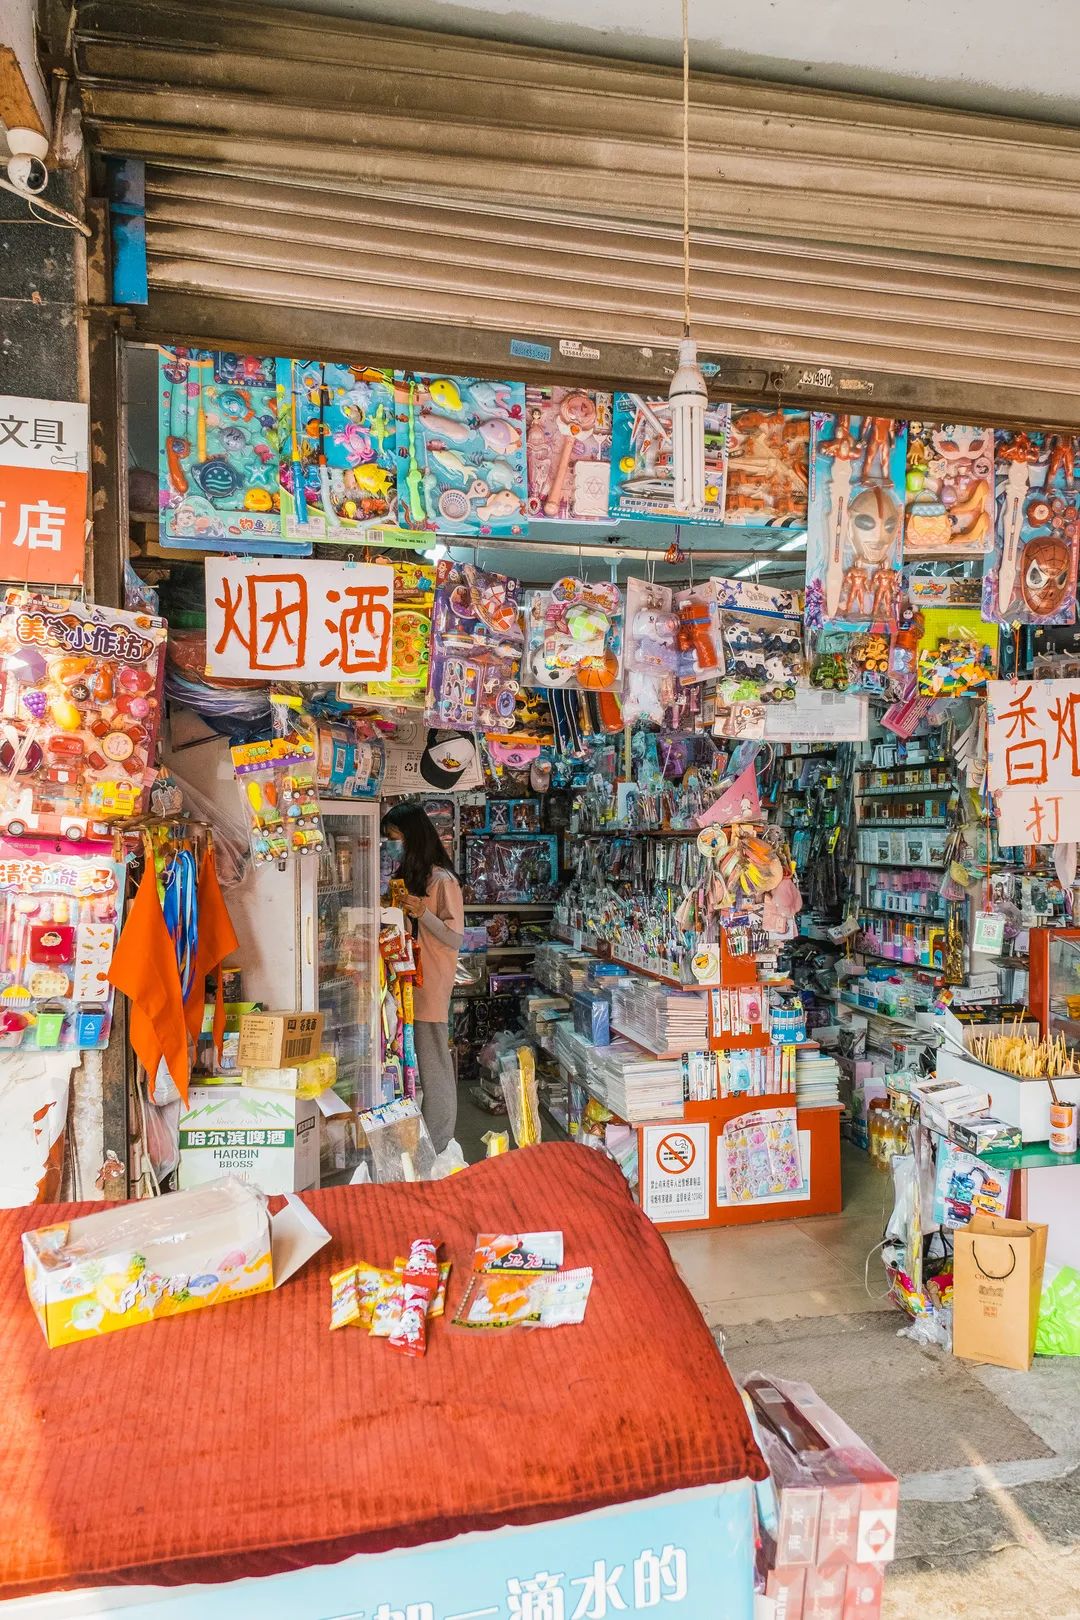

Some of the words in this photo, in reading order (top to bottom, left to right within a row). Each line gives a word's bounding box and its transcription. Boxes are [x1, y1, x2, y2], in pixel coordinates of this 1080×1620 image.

[0, 414, 67, 453] 文具
[0, 500, 66, 552] 店
[216, 574, 392, 672] 烟酒
[1026, 796, 1063, 843] 打
[187, 1129, 286, 1146] 哈尔滨啤酒
[213, 1149, 259, 1159] HARBIN
[219, 1160, 254, 1168] BBOSS
[318, 1544, 688, 1620] 一滴水的
